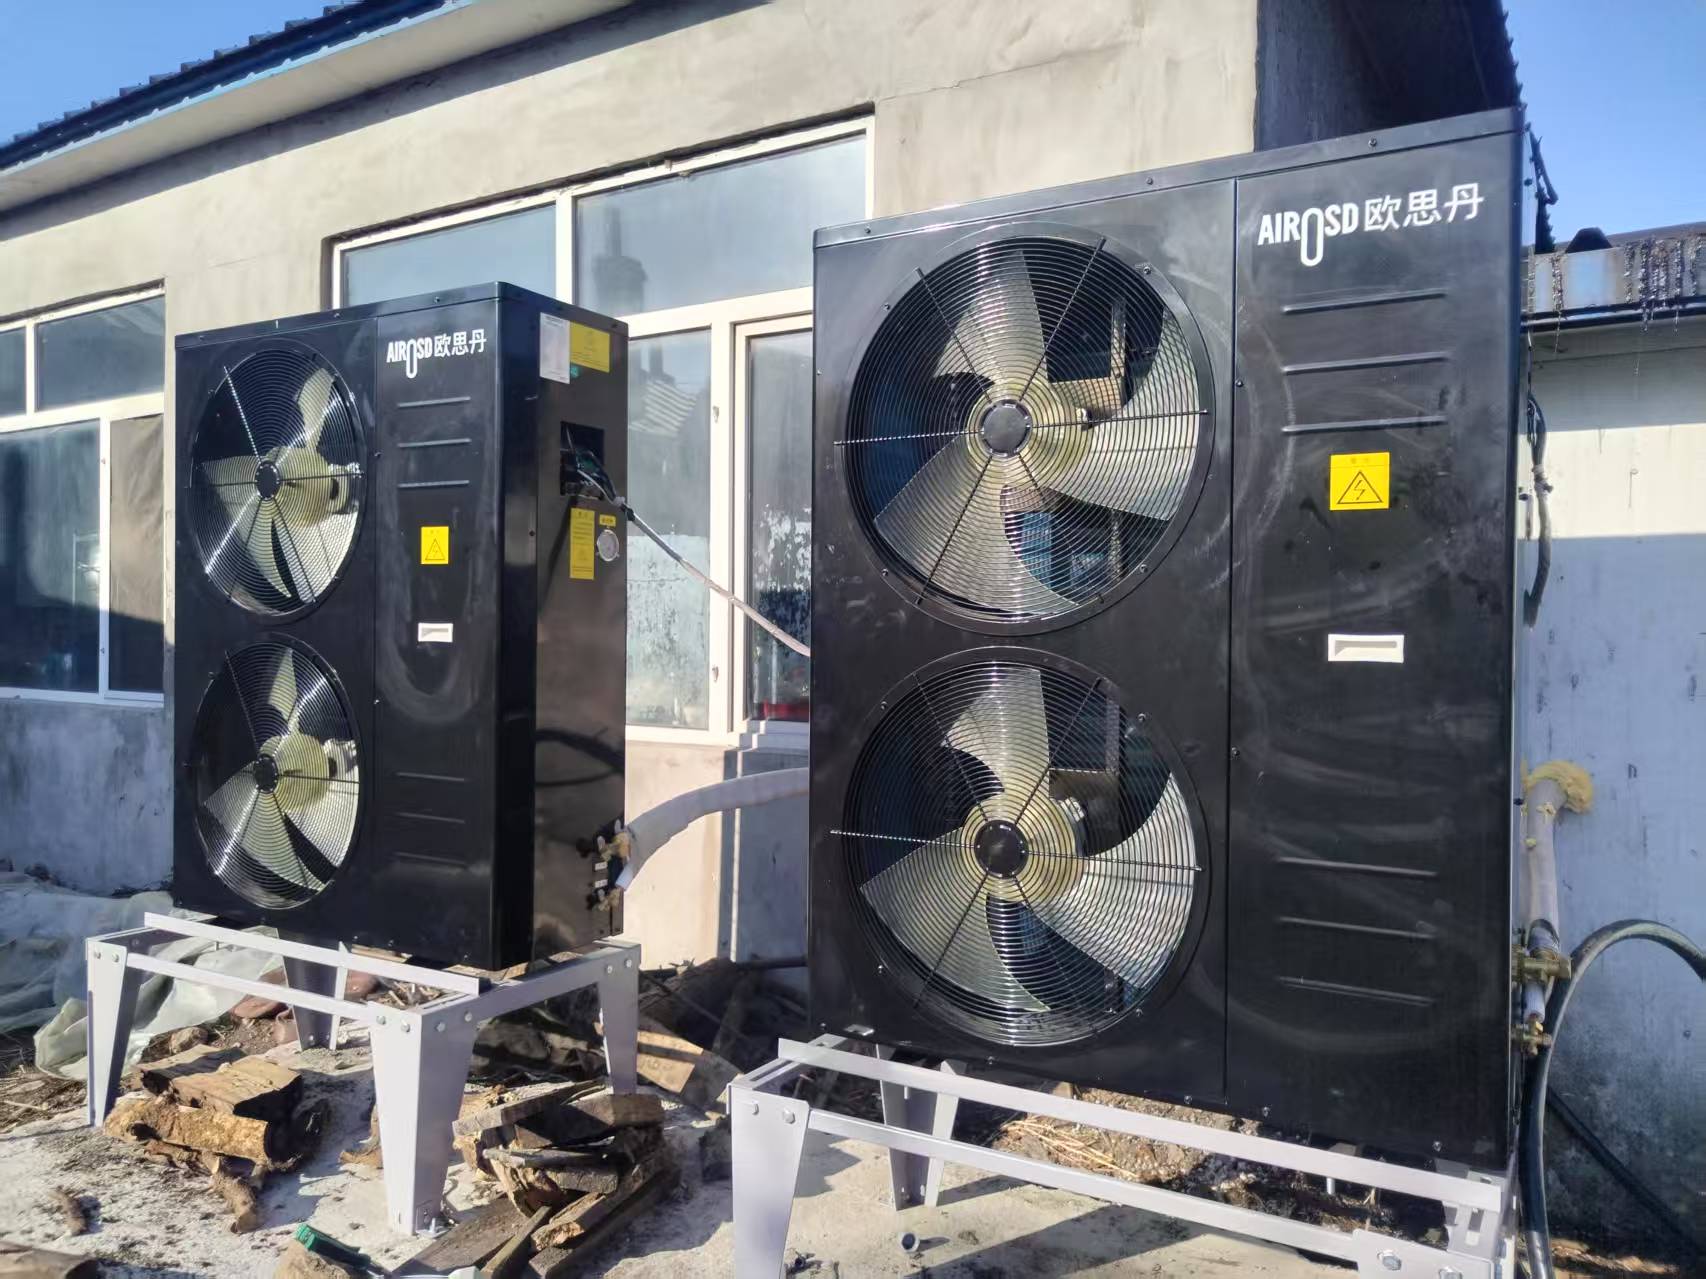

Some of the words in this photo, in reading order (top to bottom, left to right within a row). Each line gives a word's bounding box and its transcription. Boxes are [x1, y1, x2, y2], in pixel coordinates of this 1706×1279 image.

[1364, 183, 1484, 231] 欧思丹
[434, 328, 487, 357] 欧思丹
